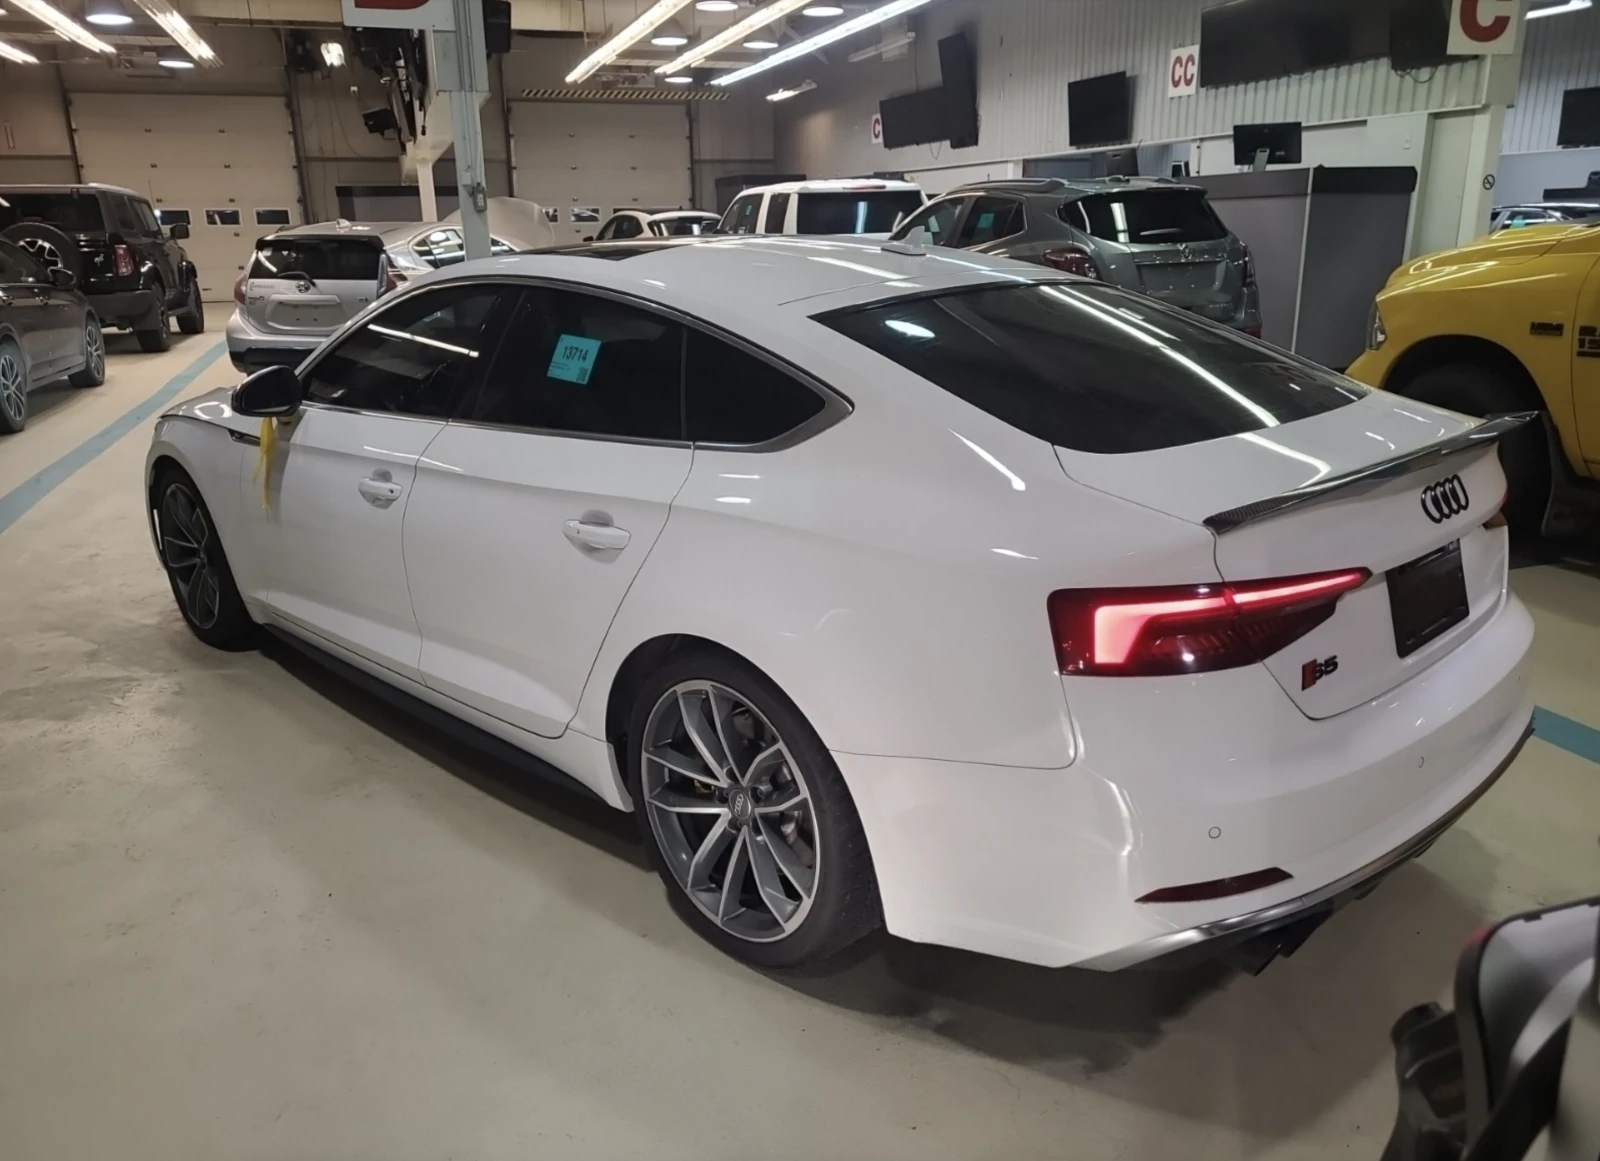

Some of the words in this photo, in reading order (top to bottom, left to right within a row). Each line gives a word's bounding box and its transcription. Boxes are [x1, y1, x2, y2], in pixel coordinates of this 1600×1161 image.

[1460, 0, 1511, 43] C
[1171, 53, 1195, 88] CC
[562, 345, 589, 363] 13714
